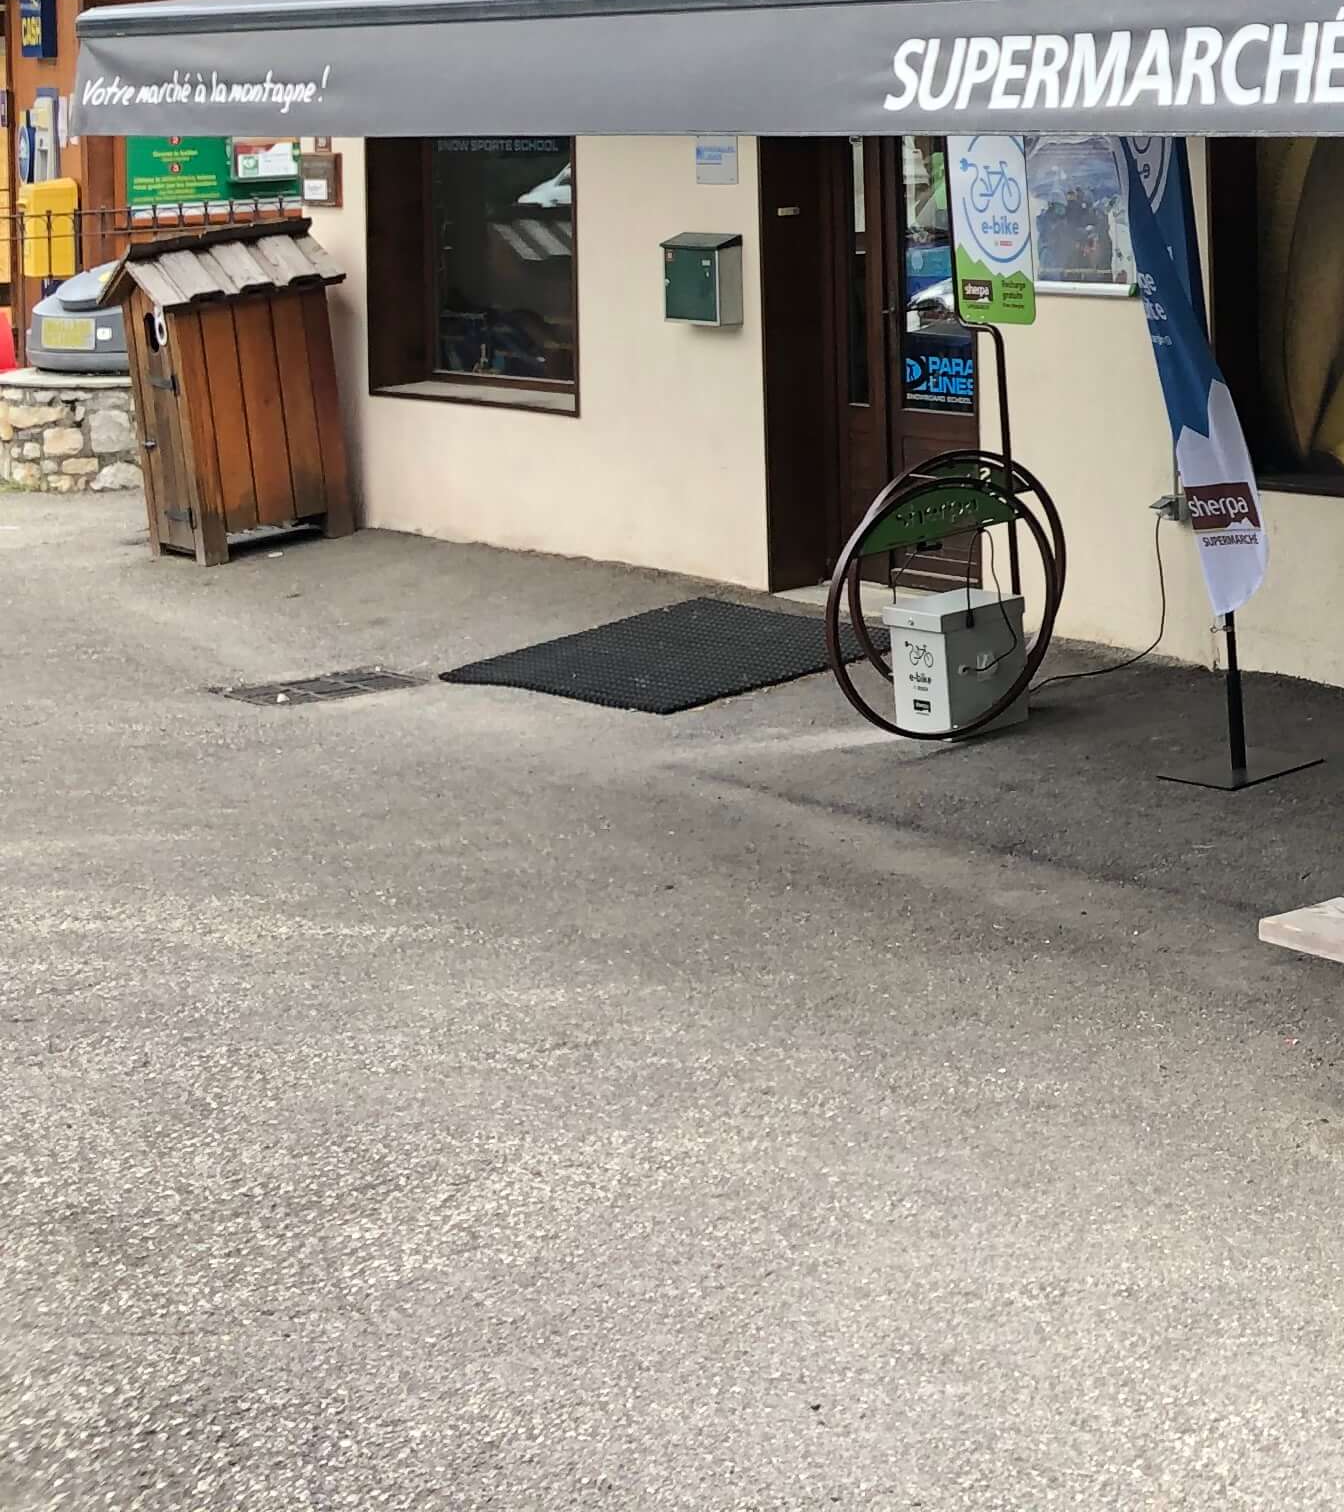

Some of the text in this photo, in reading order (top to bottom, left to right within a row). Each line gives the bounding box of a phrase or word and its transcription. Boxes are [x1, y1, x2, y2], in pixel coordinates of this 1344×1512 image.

[83, 76, 131, 105] Votre
[135, 70, 191, 104] marché
[195, 72, 205, 103] à
[212, 71, 226, 103] la
[514, 139, 559, 151] SCHOOL
[981, 216, 1020, 235] e-bike
[1188, 495, 1249, 518] sherpa
